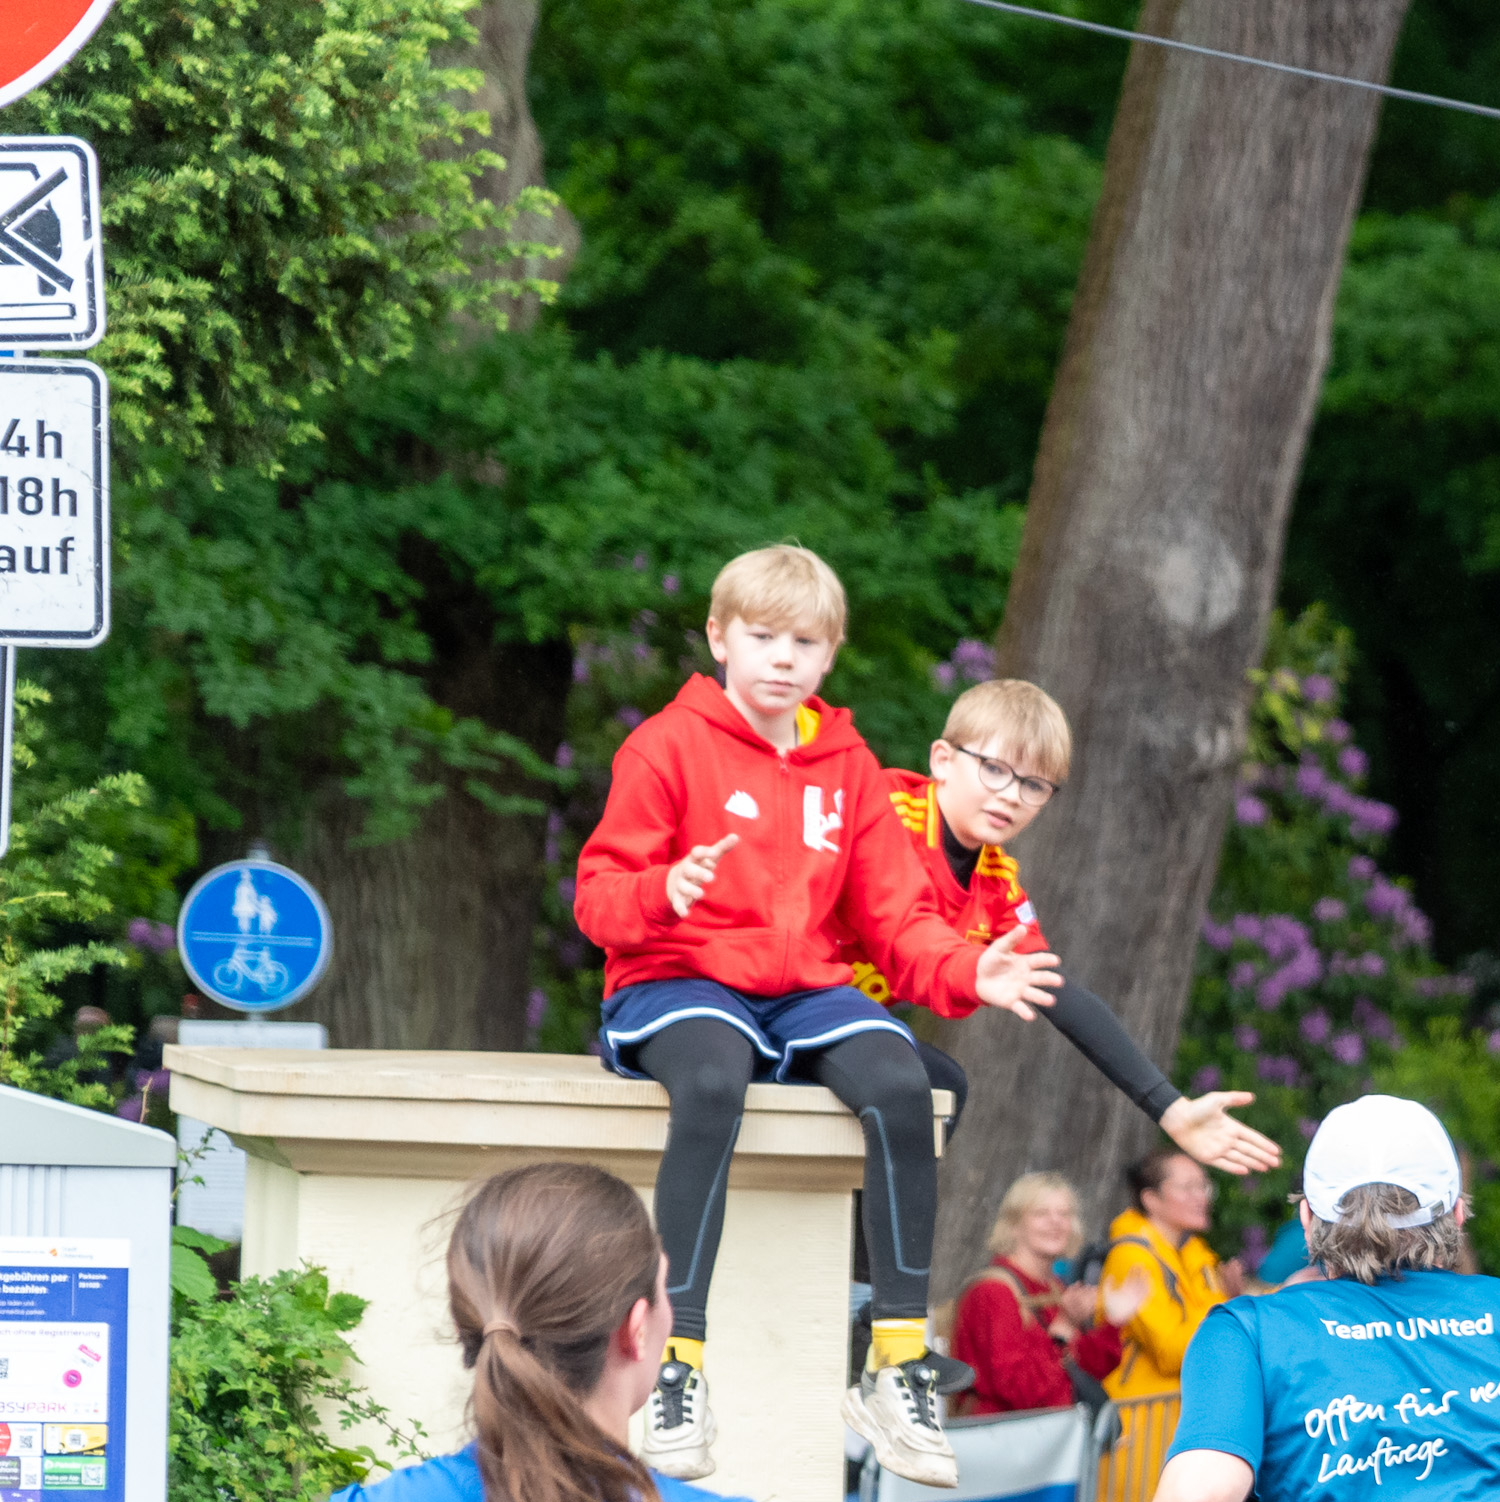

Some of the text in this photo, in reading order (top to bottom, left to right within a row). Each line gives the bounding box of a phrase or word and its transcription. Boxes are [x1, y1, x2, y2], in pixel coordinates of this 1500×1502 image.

[1320, 1318, 1392, 1340] Team
[1304, 1394, 1386, 1446] Offen
[1394, 1388, 1459, 1424] für
[1317, 1437, 1449, 1485] Laufwege
